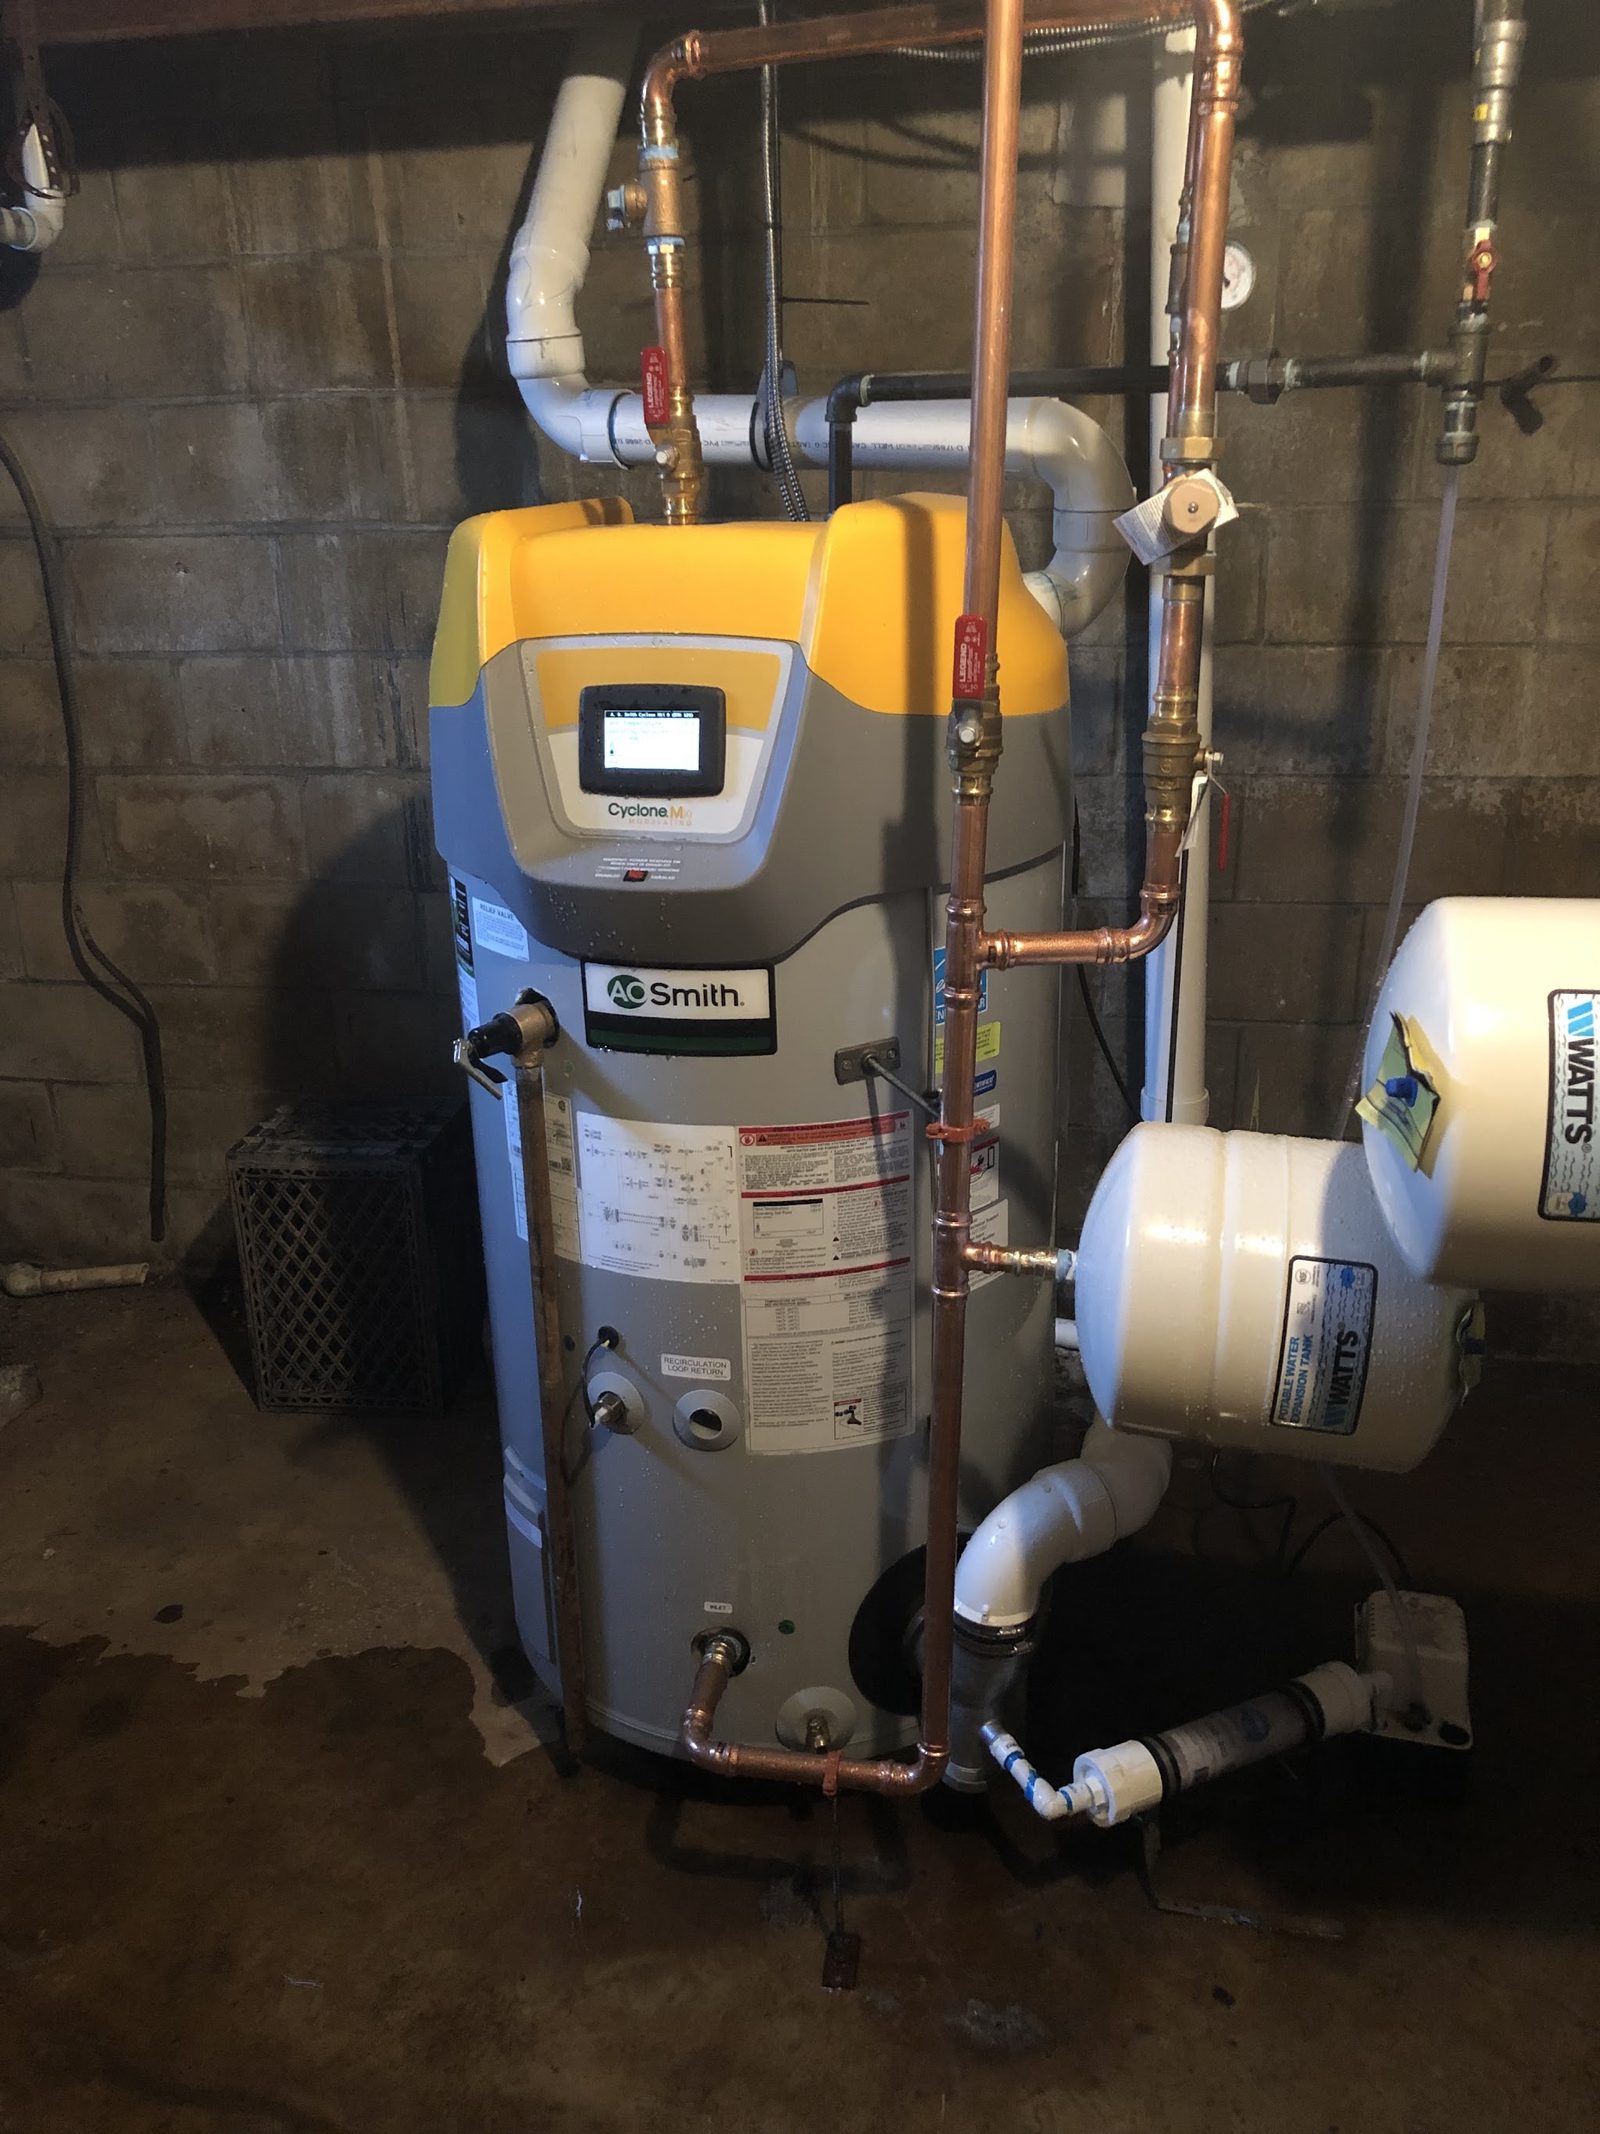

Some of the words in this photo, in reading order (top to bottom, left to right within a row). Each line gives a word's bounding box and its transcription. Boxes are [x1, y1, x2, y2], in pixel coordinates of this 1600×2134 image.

[960, 643, 968, 682] LEGEND
[608, 802, 668, 819] Cyclone
[650, 982, 739, 1007] Smith
[1564, 1037, 1595, 1145] WATTS
[663, 1357, 727, 1369] RECIRCULATION
[1285, 1336, 1300, 1377] WATER
[1299, 1334, 1313, 1367] TANK
[667, 1365, 689, 1373] LOOP
[690, 1367, 724, 1376] RETURN
[1327, 1330, 1359, 1405] WATTS
